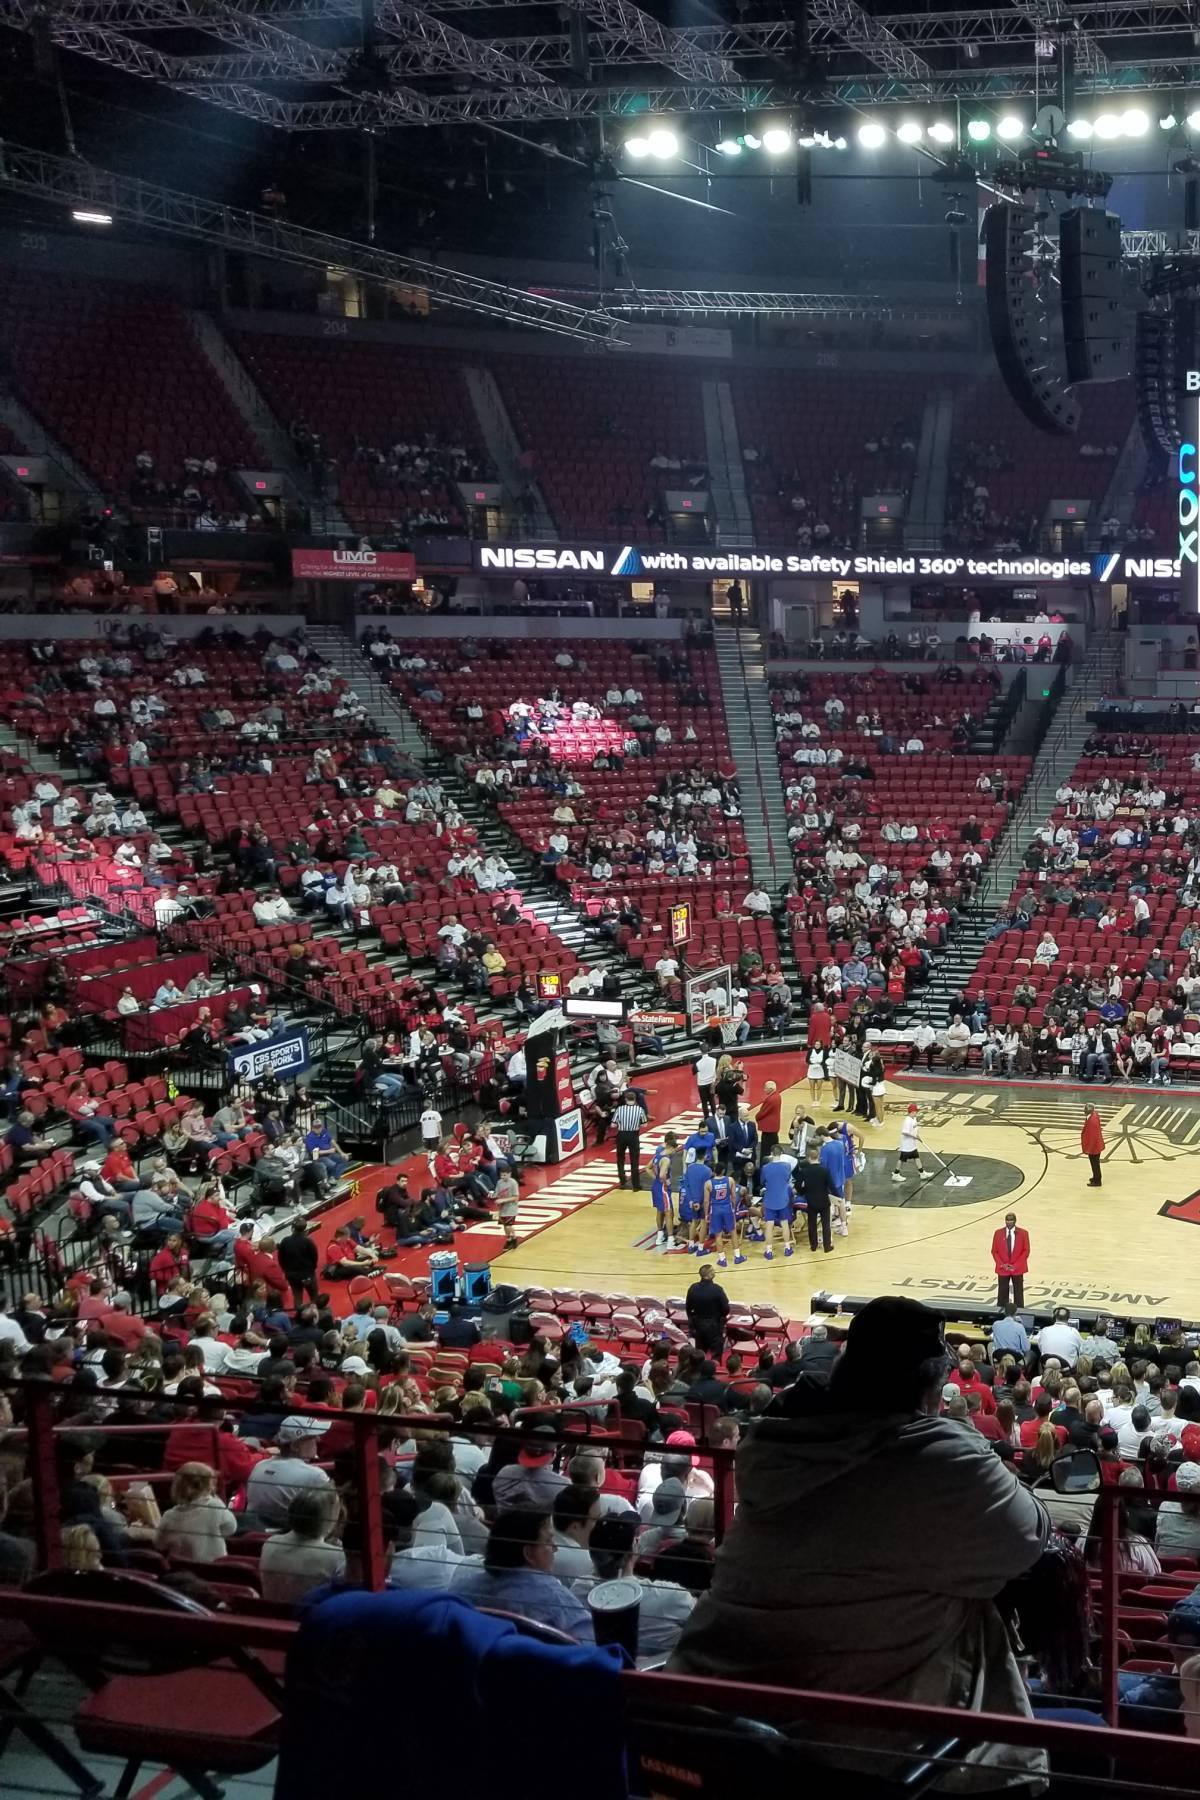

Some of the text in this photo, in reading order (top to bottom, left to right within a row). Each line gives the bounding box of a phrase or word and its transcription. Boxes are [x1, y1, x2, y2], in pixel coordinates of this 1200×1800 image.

[1179, 443, 1198, 564] COX
[333, 550, 377, 564] UMC
[480, 547, 604, 570] NISSAN
[641, 553, 687, 571] with
[693, 553, 784, 572] available
[787, 555, 850, 577] Safety
[855, 555, 915, 575] Shield
[967, 557, 1091, 579] technologies
[254, 1042, 300, 1065] CBS SPORTS
